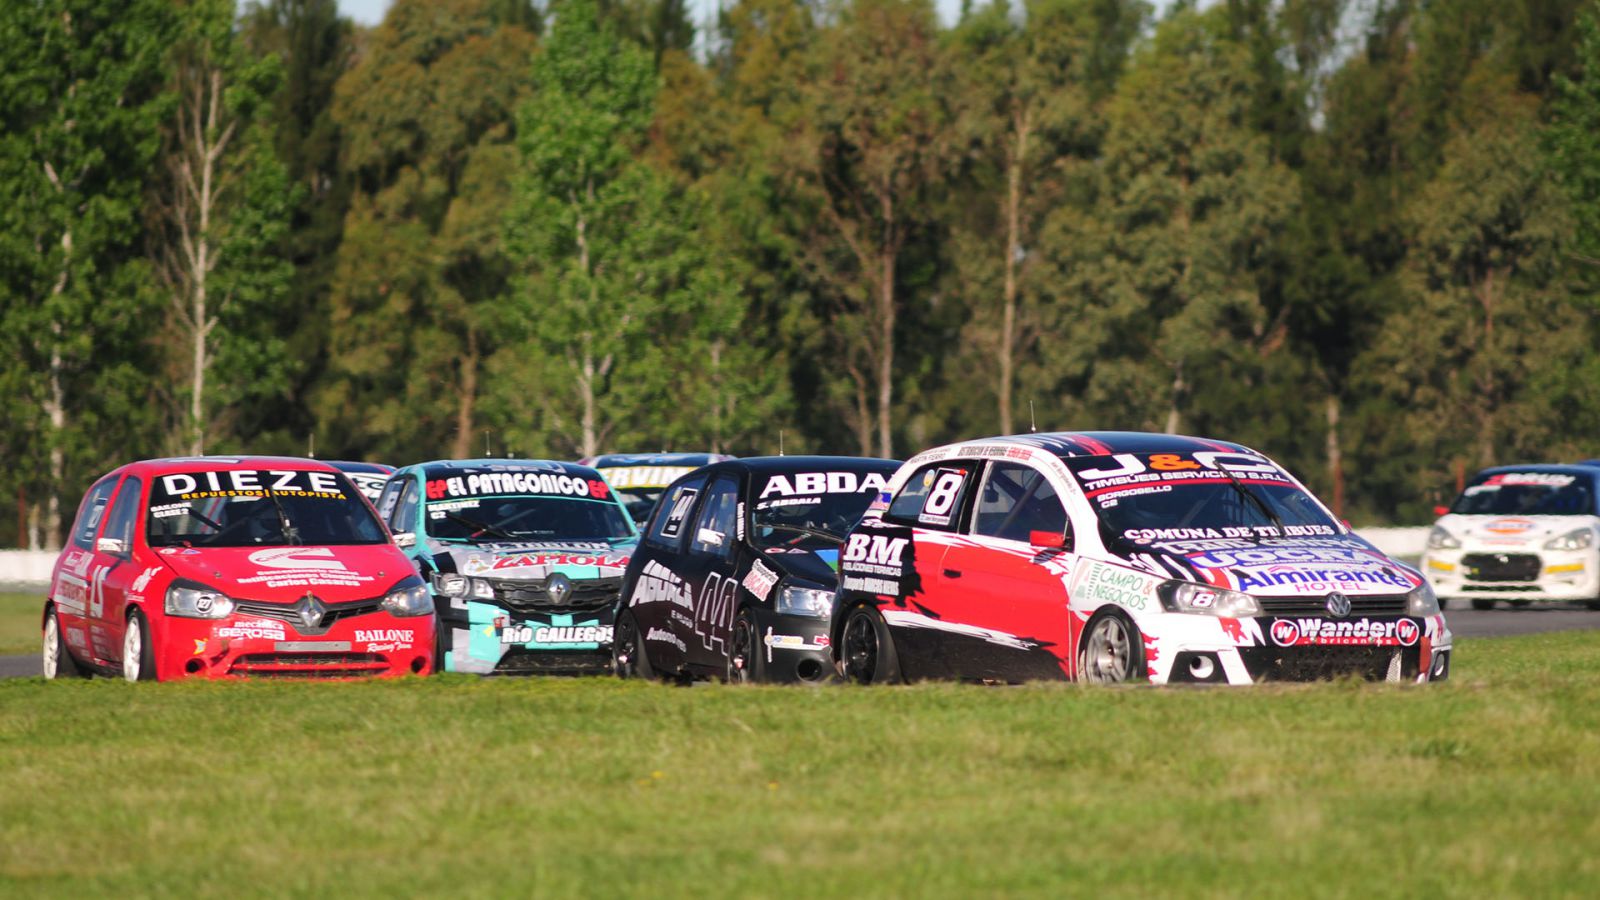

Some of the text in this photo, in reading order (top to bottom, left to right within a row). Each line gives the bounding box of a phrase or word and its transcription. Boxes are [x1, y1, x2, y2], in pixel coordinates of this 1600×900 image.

[162, 470, 341, 495] DIEZE
[426, 473, 609, 499] EP EL PATAGONICO EP
[759, 472, 891, 499] ABDA
[1085, 472, 1160, 490] TIMBÚES
[181, 490, 347, 500] REPUESTOS AUTOPISTA
[925, 472, 964, 515] 8
[1097, 485, 1172, 502] BORGOBELLO
[770, 498, 821, 507] ABDALA
[1124, 527, 1220, 540] COMUNA
[1221, 526, 1255, 539] DE
[843, 533, 909, 567] BM
[493, 554, 630, 570] ZAPIOLA
[1100, 568, 1144, 591] CAMPO
[1236, 567, 1411, 592] Almirante
[1295, 581, 1368, 592] HOTEL
[1093, 584, 1148, 611] NEGOCIOS
[1192, 593, 1215, 607] 8
[354, 629, 414, 643] BAILONE
[535, 626, 614, 643] GALLEGOS
[1297, 618, 1395, 637] Wander
[1303, 637, 1392, 646] bricanes
